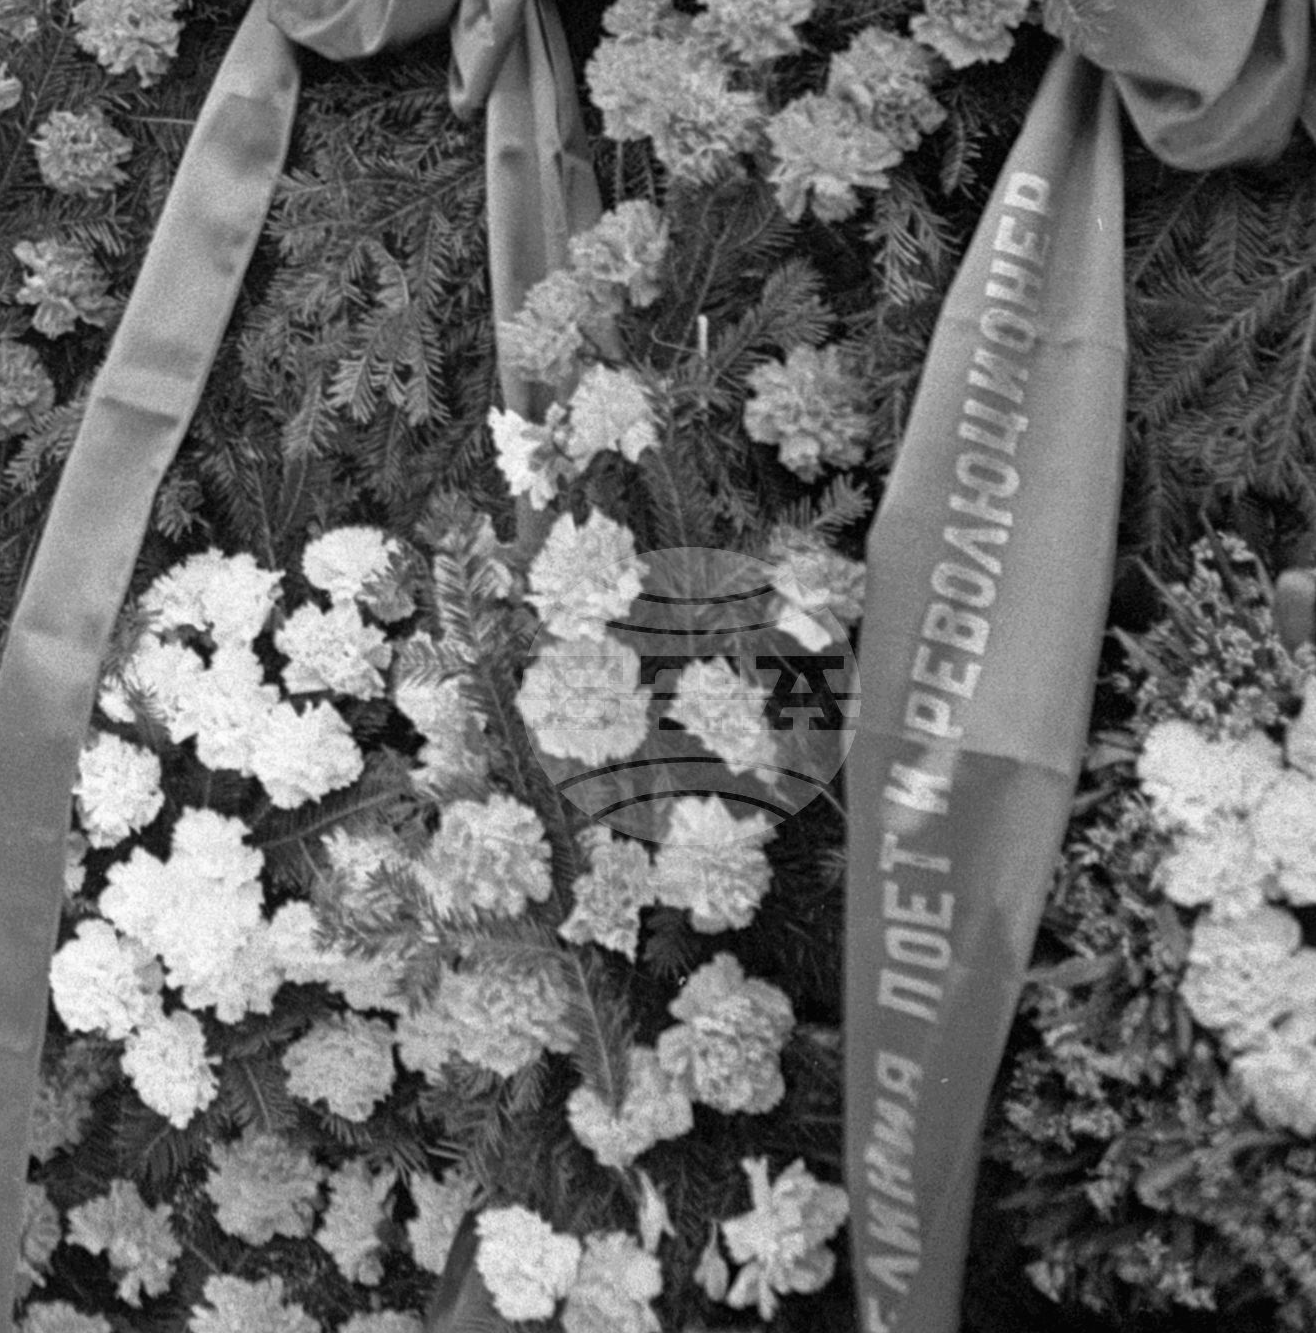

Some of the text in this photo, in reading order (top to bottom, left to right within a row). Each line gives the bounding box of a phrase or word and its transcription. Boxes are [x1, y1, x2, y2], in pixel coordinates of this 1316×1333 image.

[908, 171, 1053, 737] РЕВОЛЮЦИОНЕР
[885, 759, 953, 815] И
[879, 831, 955, 1021] ПОЕТ
